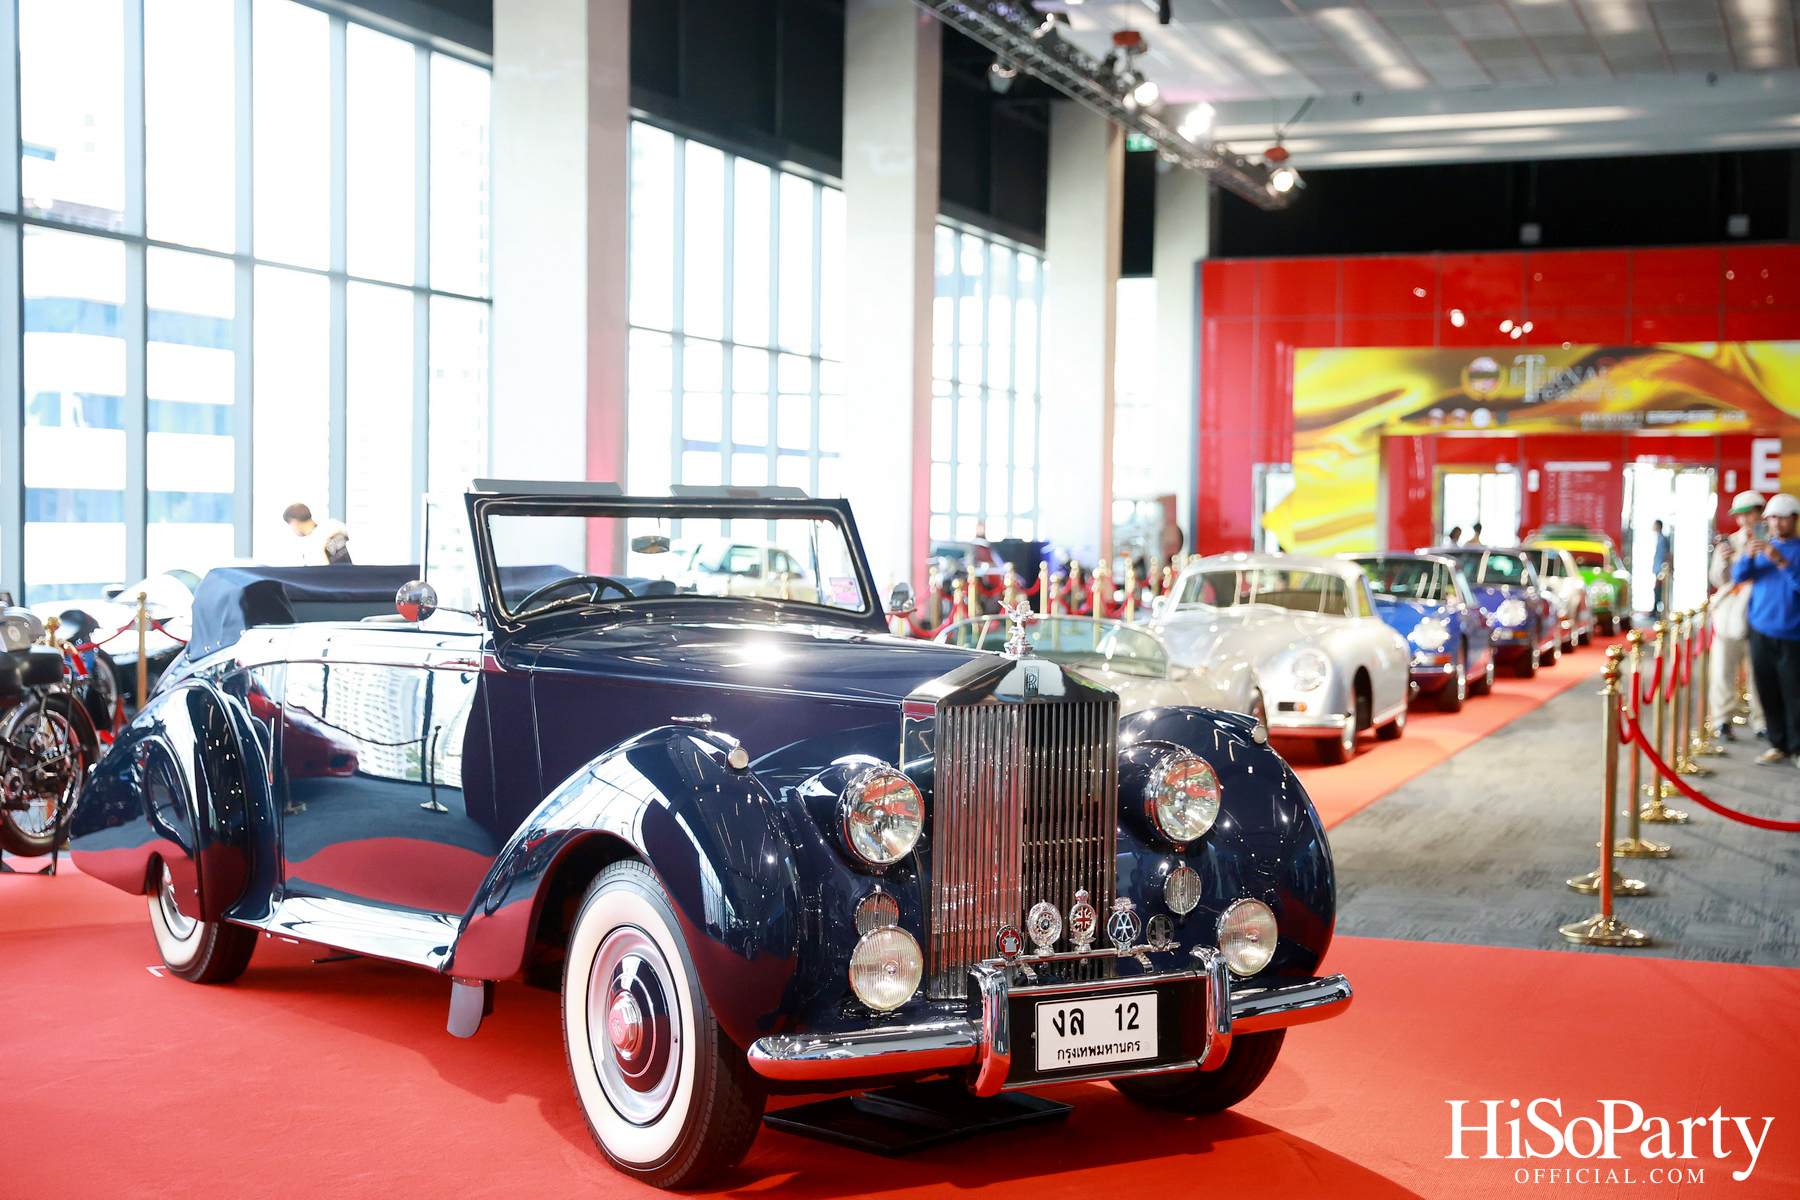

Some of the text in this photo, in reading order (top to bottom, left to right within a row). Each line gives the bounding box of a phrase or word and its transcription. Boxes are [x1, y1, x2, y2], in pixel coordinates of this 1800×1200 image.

[1751, 438, 1782, 493] E
[1052, 1002, 1140, 1038] งล 12
[1057, 1040, 1141, 1064] กรุงเทพมหานคร
